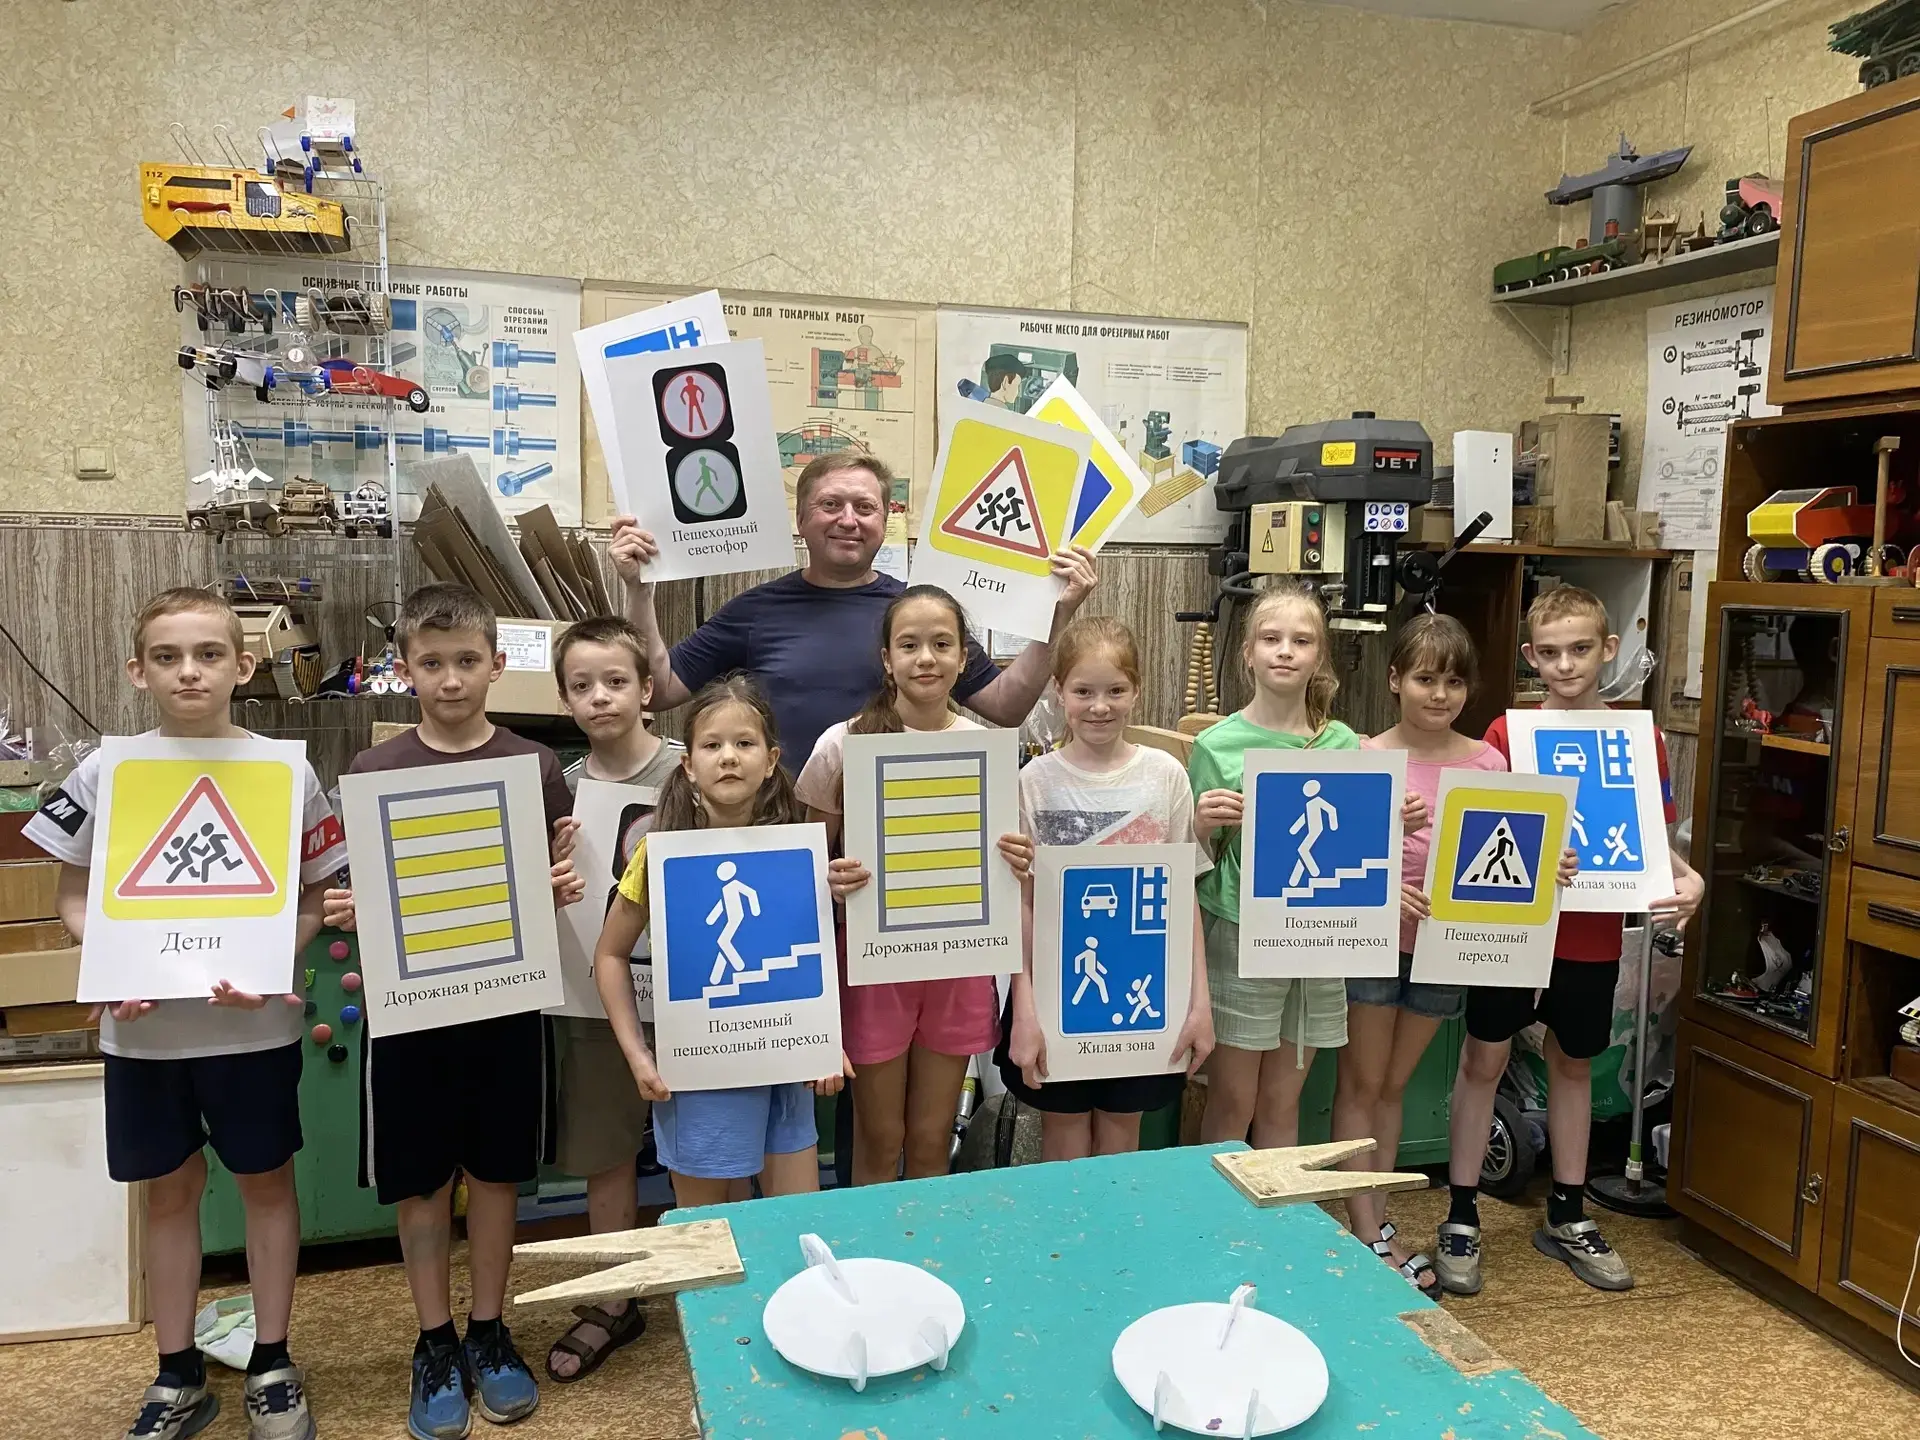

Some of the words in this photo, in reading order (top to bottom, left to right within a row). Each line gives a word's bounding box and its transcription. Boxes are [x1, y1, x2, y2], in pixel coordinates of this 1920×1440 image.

[146, 170, 163, 178] 112
[425, 285, 468, 298] РАБОТЫ
[508, 306, 544, 316] СПОСОБЫ
[722, 304, 746, 316] ЕСТО
[752, 306, 772, 318] ДЛЯ
[779, 308, 830, 322] ТОКАРНЫХ
[835, 312, 865, 324] РАБОТ
[1675, 300, 1764, 328] РЕЗИНОМОТОР
[503, 316, 548, 326] ОТРЕЗАНИЯ
[504, 325, 548, 335] ЗАГОТОВКИ
[1020, 322, 1053, 334] РАБОЧЕЕ
[1055, 323, 1080, 336] МЕСТО
[1081, 325, 1098, 337] ДЛЯ
[1100, 326, 1145, 339] ФРЕЗЕРНЫХ
[1147, 329, 1170, 341] РАБОТ
[1375, 457, 1417, 470] JET
[672, 521, 758, 543] Пешеходный
[688, 540, 748, 556] светофор
[962, 569, 1006, 593] Дети
[1608, 880, 1637, 890] зона
[1284, 916, 1358, 929] Подземный
[160, 932, 222, 955] Дети
[1253, 936, 1334, 948] пешеходный
[1337, 938, 1388, 949] переход
[1444, 927, 1528, 944] Пешеходный
[862, 941, 938, 959] Дорожная
[943, 935, 1009, 953] разметка
[1458, 951, 1509, 965] переход
[384, 982, 469, 1008] Дорожная
[474, 969, 547, 995] разметка
[708, 1013, 793, 1034] Подземный
[672, 1037, 766, 1057] пешеходный
[770, 1033, 829, 1051] переход
[1078, 1041, 1122, 1055] Жилая
[1126, 1041, 1155, 1052] зона
